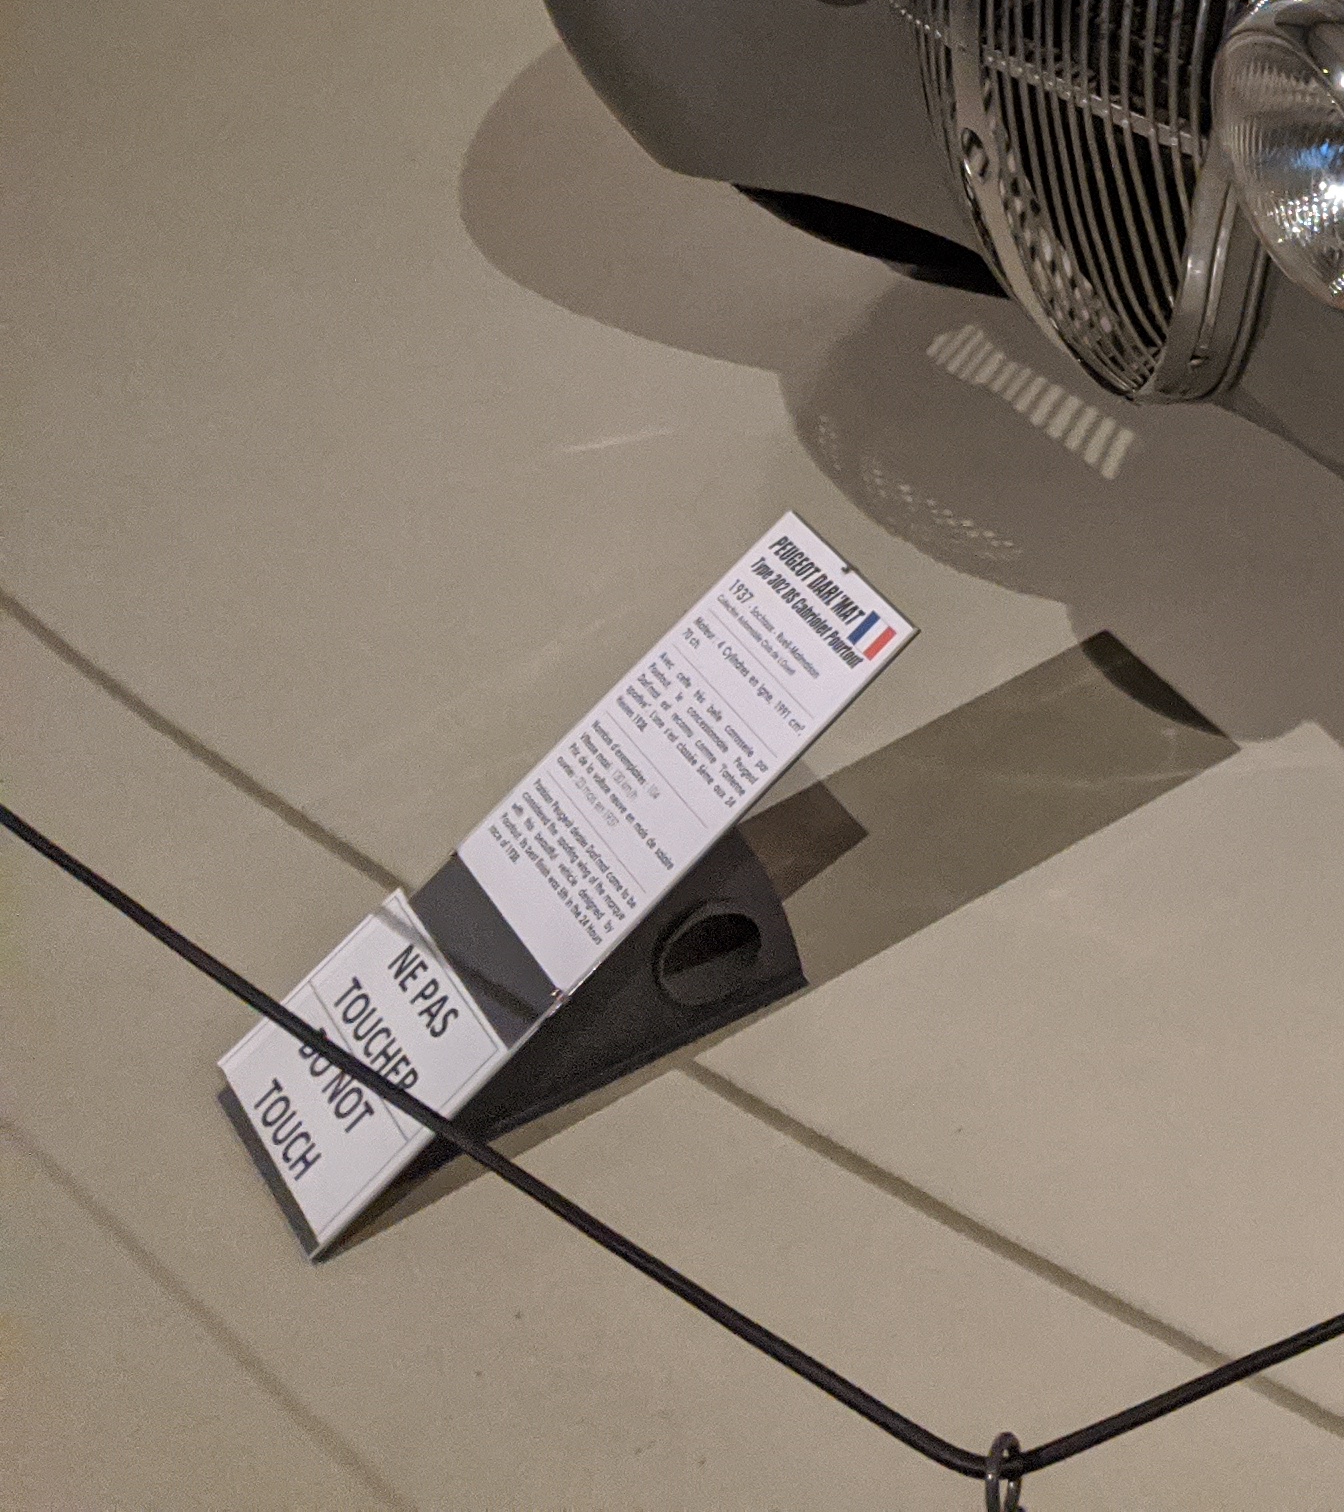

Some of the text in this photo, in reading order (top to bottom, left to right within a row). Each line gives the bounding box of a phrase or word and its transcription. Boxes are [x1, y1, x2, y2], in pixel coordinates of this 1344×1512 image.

[750, 556, 774, 580] Type
[766, 573, 790, 594] 302
[790, 597, 832, 637] Cabriolet
[822, 629, 864, 669] Pourtout
[768, 535, 865, 625] PEUGEOT DARL'MAT
[728, 578, 754, 603] 1937
[749, 605, 775, 632] Sochaux
[775, 631, 819, 678] Rueil-Malmaison
[737, 615, 762, 642] Automobile
[760, 639, 772, 653] Club
[658, 651, 674, 670] Avec
[676, 672, 691, 688] cette
[693, 689, 705, 703] très
[706, 704, 722, 722] belle
[754, 759, 768, 772] par
[721, 646, 750, 677] Cylindres
[774, 700, 791, 718] 1991
[579, 731, 598, 755] Vitesse
[591, 719, 613, 745] Nombre
[659, 700, 671, 711] est
[694, 739, 716, 763] comme
[675, 742, 697, 766] classée
[713, 784, 726, 798] aux
[733, 755, 759, 785] Peugeot
[550, 800, 574, 828] Peugeot
[605, 871, 623, 892] came
[568, 742, 580, 757] Prix
[592, 772, 611, 794] voiture
[609, 793, 627, 813] neuve
[633, 822, 648, 839] mois
[654, 847, 674, 870] salaire
[522, 791, 551, 825] considered
[546, 821, 558, 836] the
[556, 836, 579, 864] sporting
[576, 860, 591, 879] wing
[594, 881, 605, 895] the
[603, 894, 625, 920] marque
[524, 845, 539, 861] best
[548, 876, 560, 890] was
[557, 886, 568, 900] 5th
[570, 903, 581, 918] the
[585, 922, 602, 945] Hours
[533, 832, 558, 860] beautiful
[558, 863, 577, 886] vehicle
[577, 888, 605, 920] designed
[387, 944, 459, 1038] NE PAS
[253, 1077, 322, 1182] TOUCH
[321, 1067, 375, 1134] NOT
